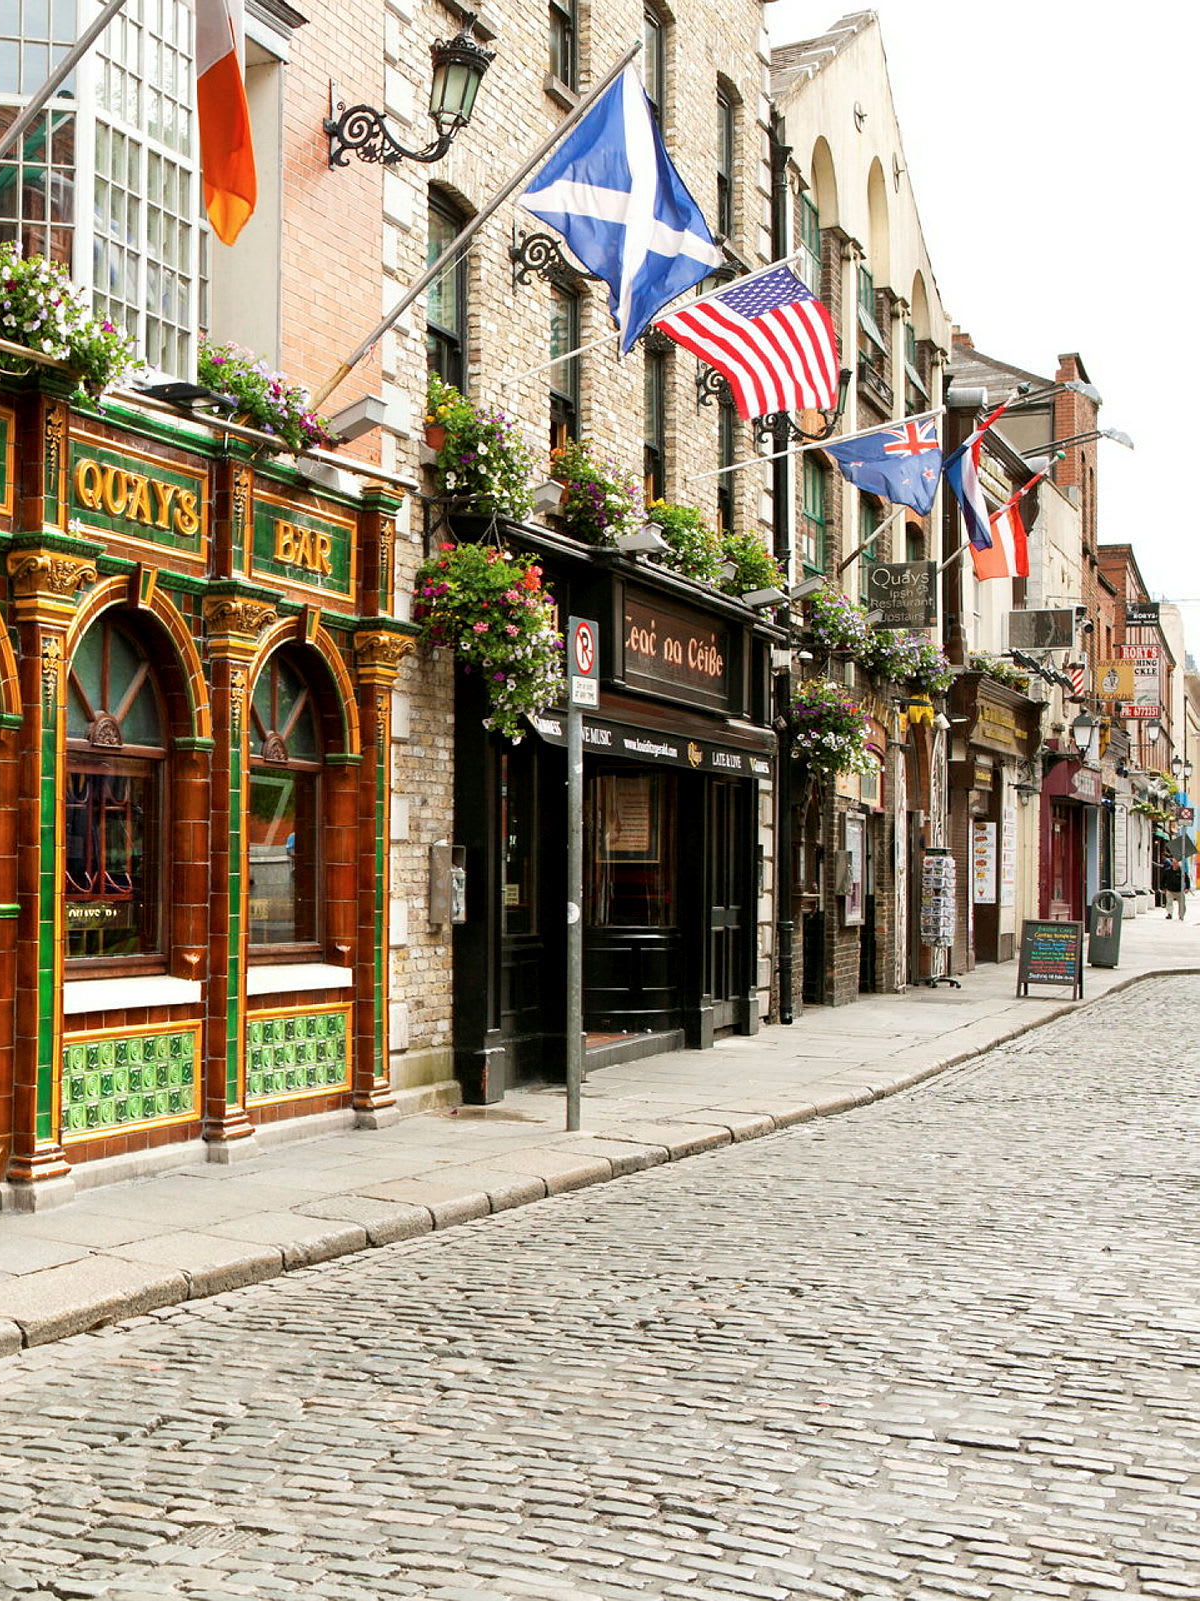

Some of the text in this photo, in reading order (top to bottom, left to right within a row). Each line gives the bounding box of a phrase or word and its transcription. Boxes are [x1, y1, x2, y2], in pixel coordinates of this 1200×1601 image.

[273, 518, 333, 576] BAR
[872, 568, 930, 589] Quays
[664, 637, 682, 664] na
[1122, 647, 1157, 659] RORY'S
[591, 728, 612, 746] MUSIC
